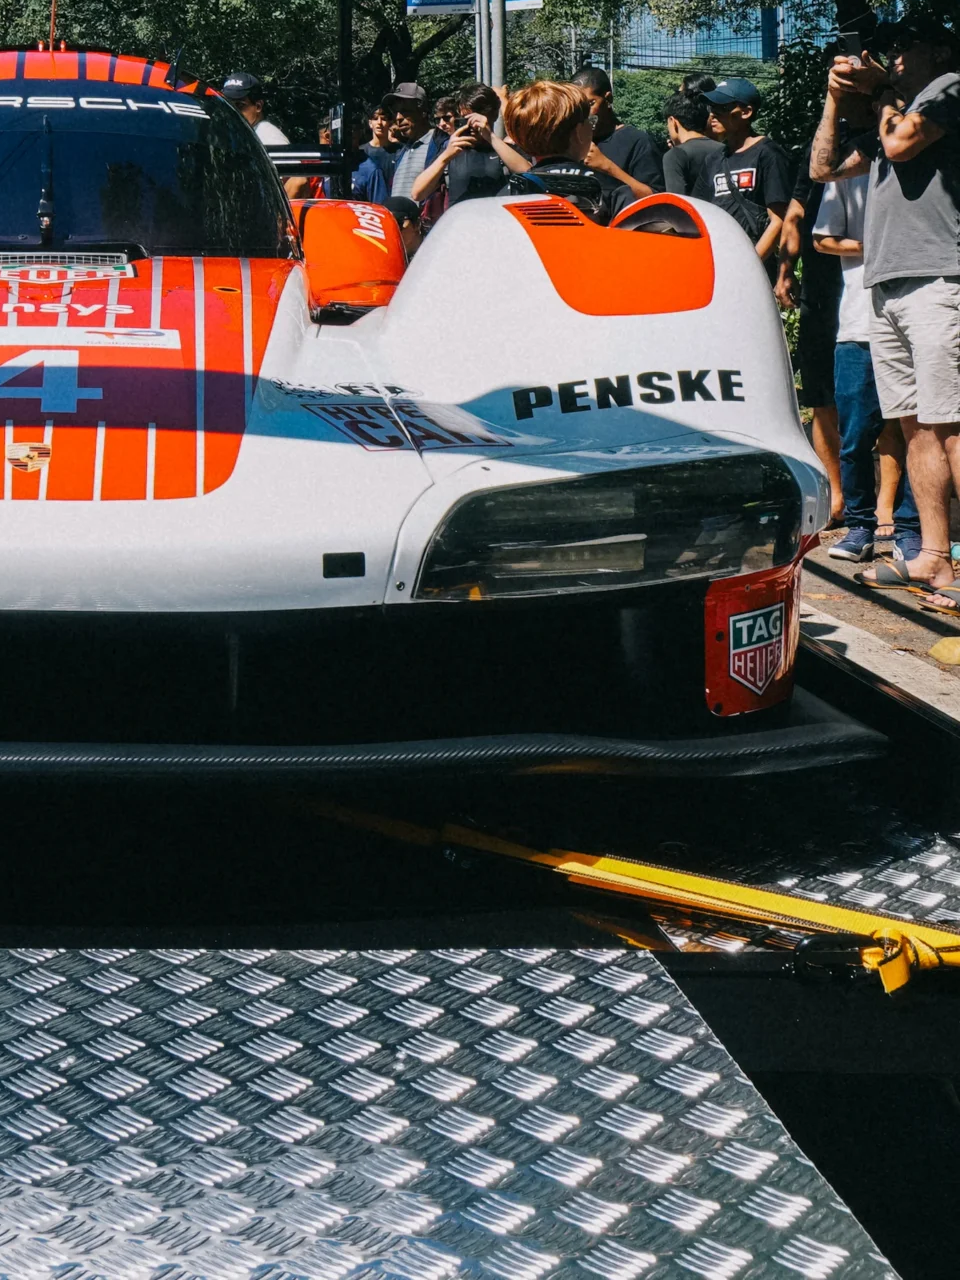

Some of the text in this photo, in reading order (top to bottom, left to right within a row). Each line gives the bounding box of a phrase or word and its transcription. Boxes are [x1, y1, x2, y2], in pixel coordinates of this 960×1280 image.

[512, 370, 746, 421] PENSKE
[735, 610, 781, 645] TAG
[734, 644, 781, 687] HEUER
